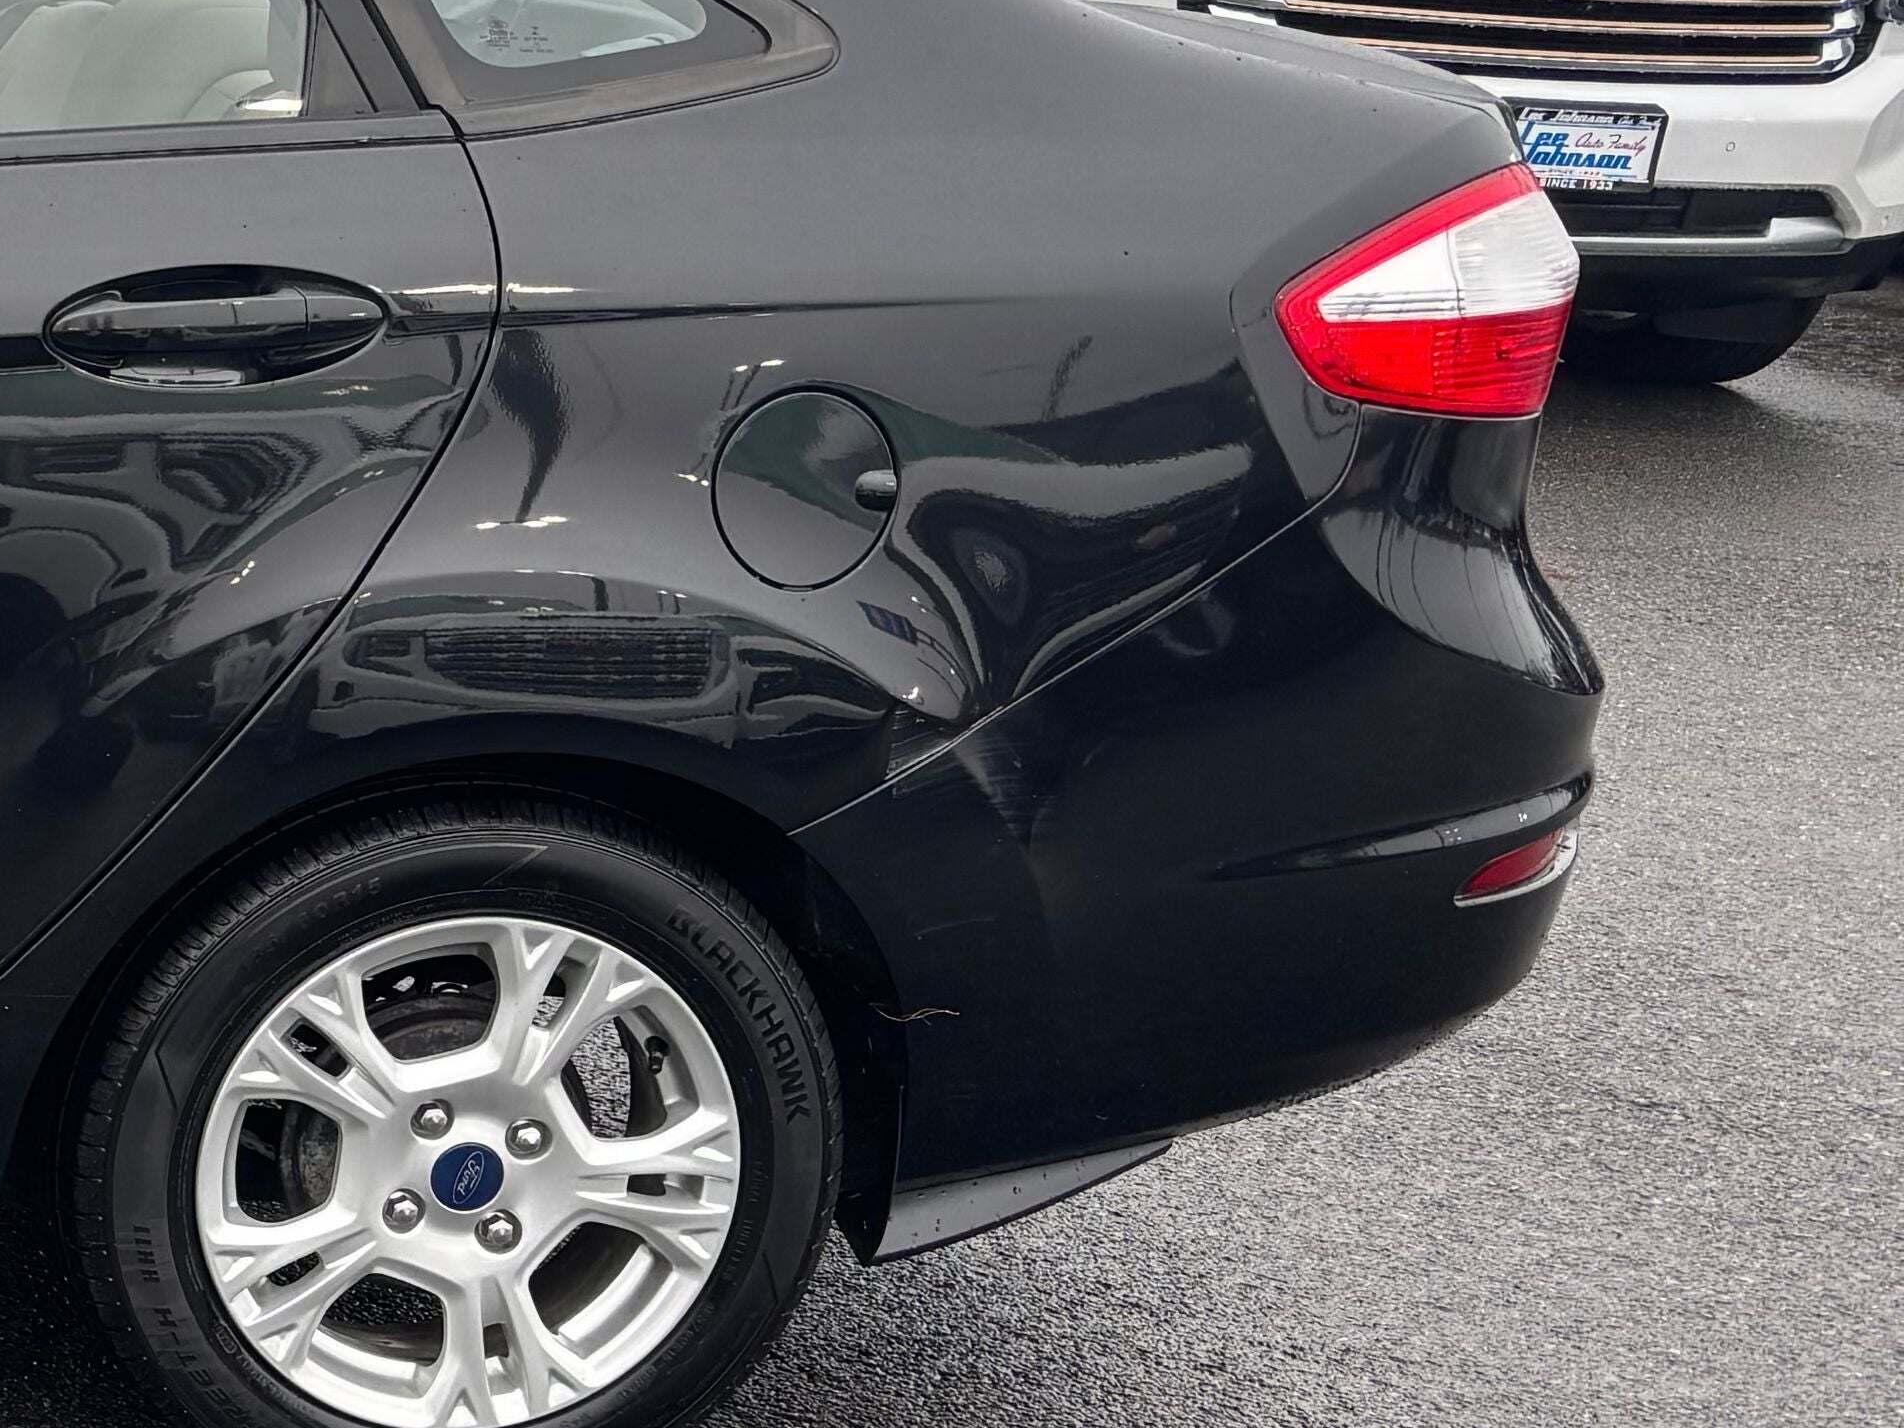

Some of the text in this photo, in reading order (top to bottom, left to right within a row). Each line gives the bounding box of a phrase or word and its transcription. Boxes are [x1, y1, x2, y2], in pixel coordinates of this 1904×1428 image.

[1520, 120, 1648, 157] Lee Auto Family
[1526, 140, 1633, 170] Johnson
[1583, 178, 1615, 191] 1933
[664, 903, 812, 1127] BLACKHAWK
[456, 1158, 482, 1197] Ford
